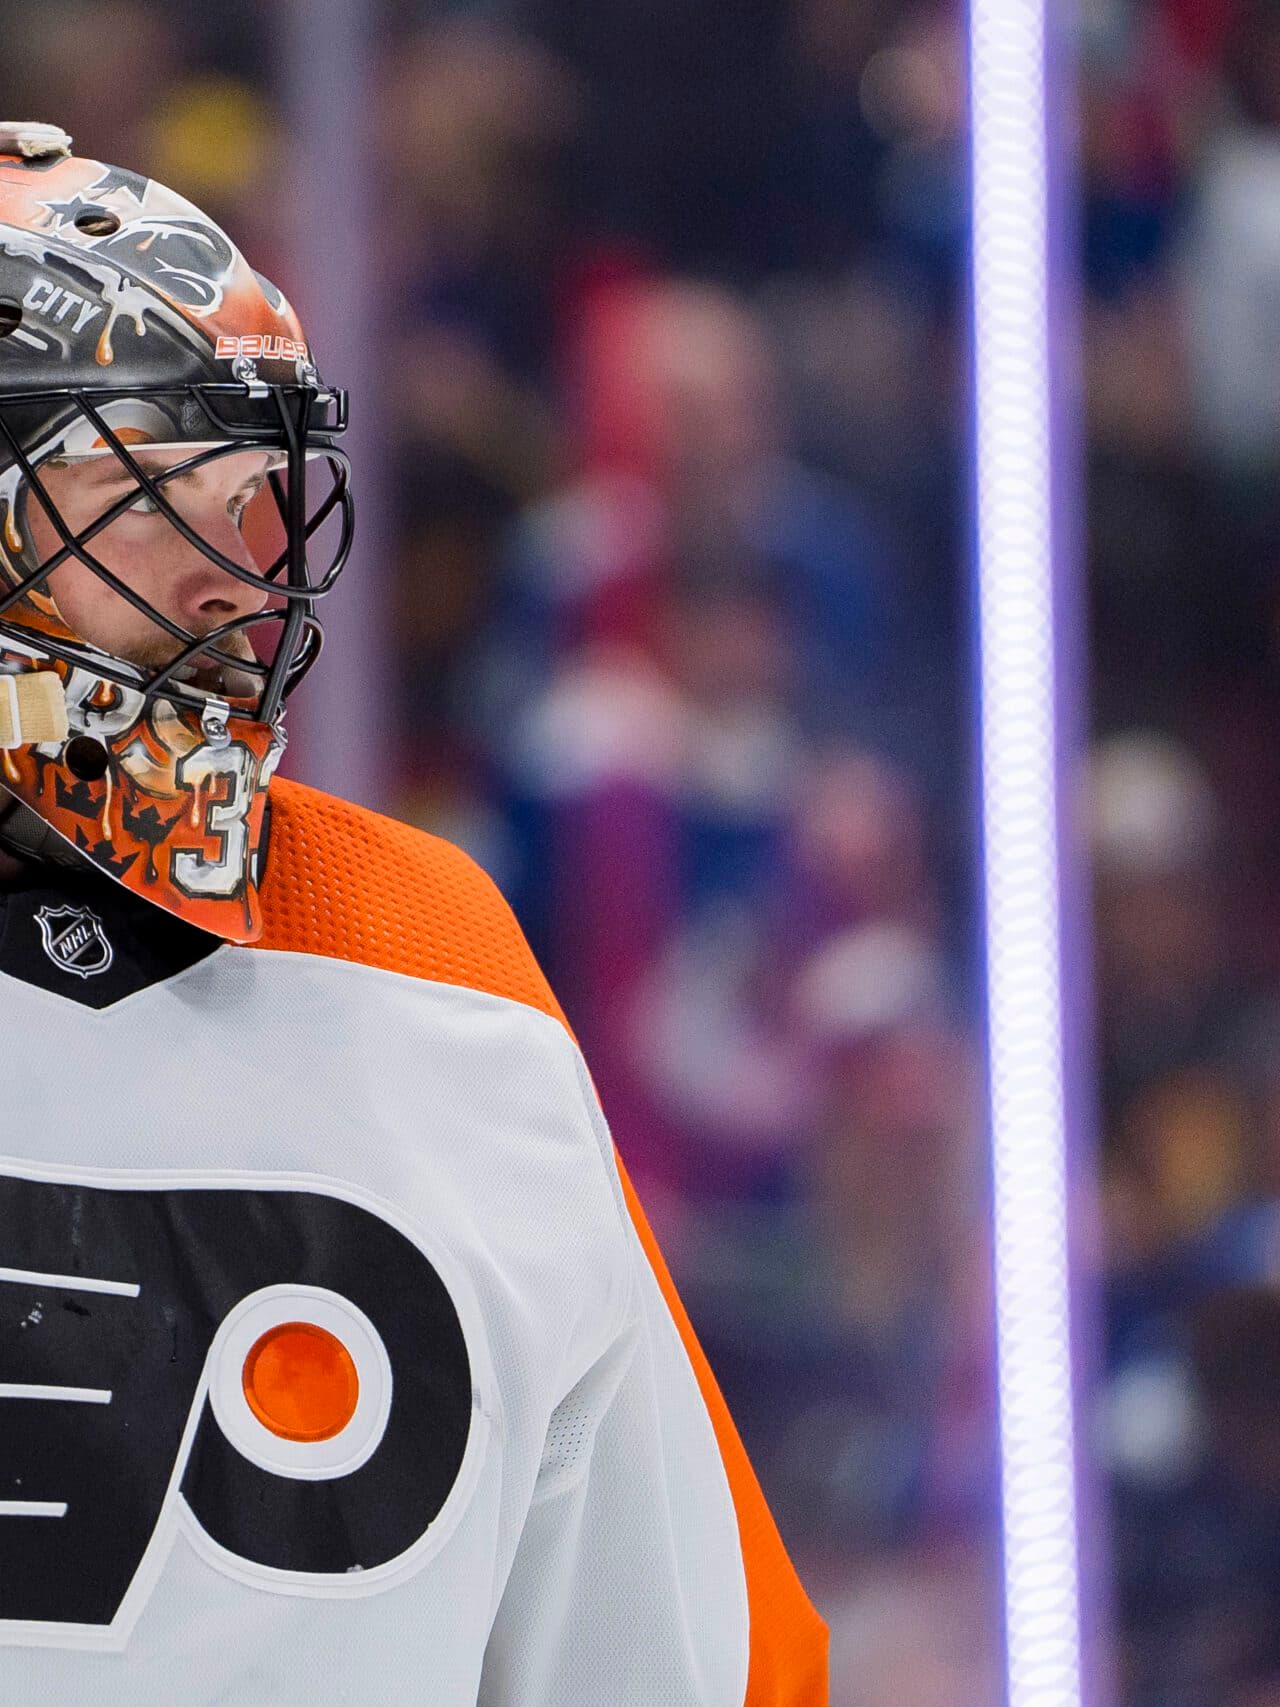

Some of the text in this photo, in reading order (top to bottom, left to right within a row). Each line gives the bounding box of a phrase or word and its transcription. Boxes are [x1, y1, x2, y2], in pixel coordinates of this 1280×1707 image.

[23, 279, 103, 334] CITY
[215, 335, 308, 361] BAUER
[170, 741, 286, 898] 3
[59, 924, 94, 958] NHL
